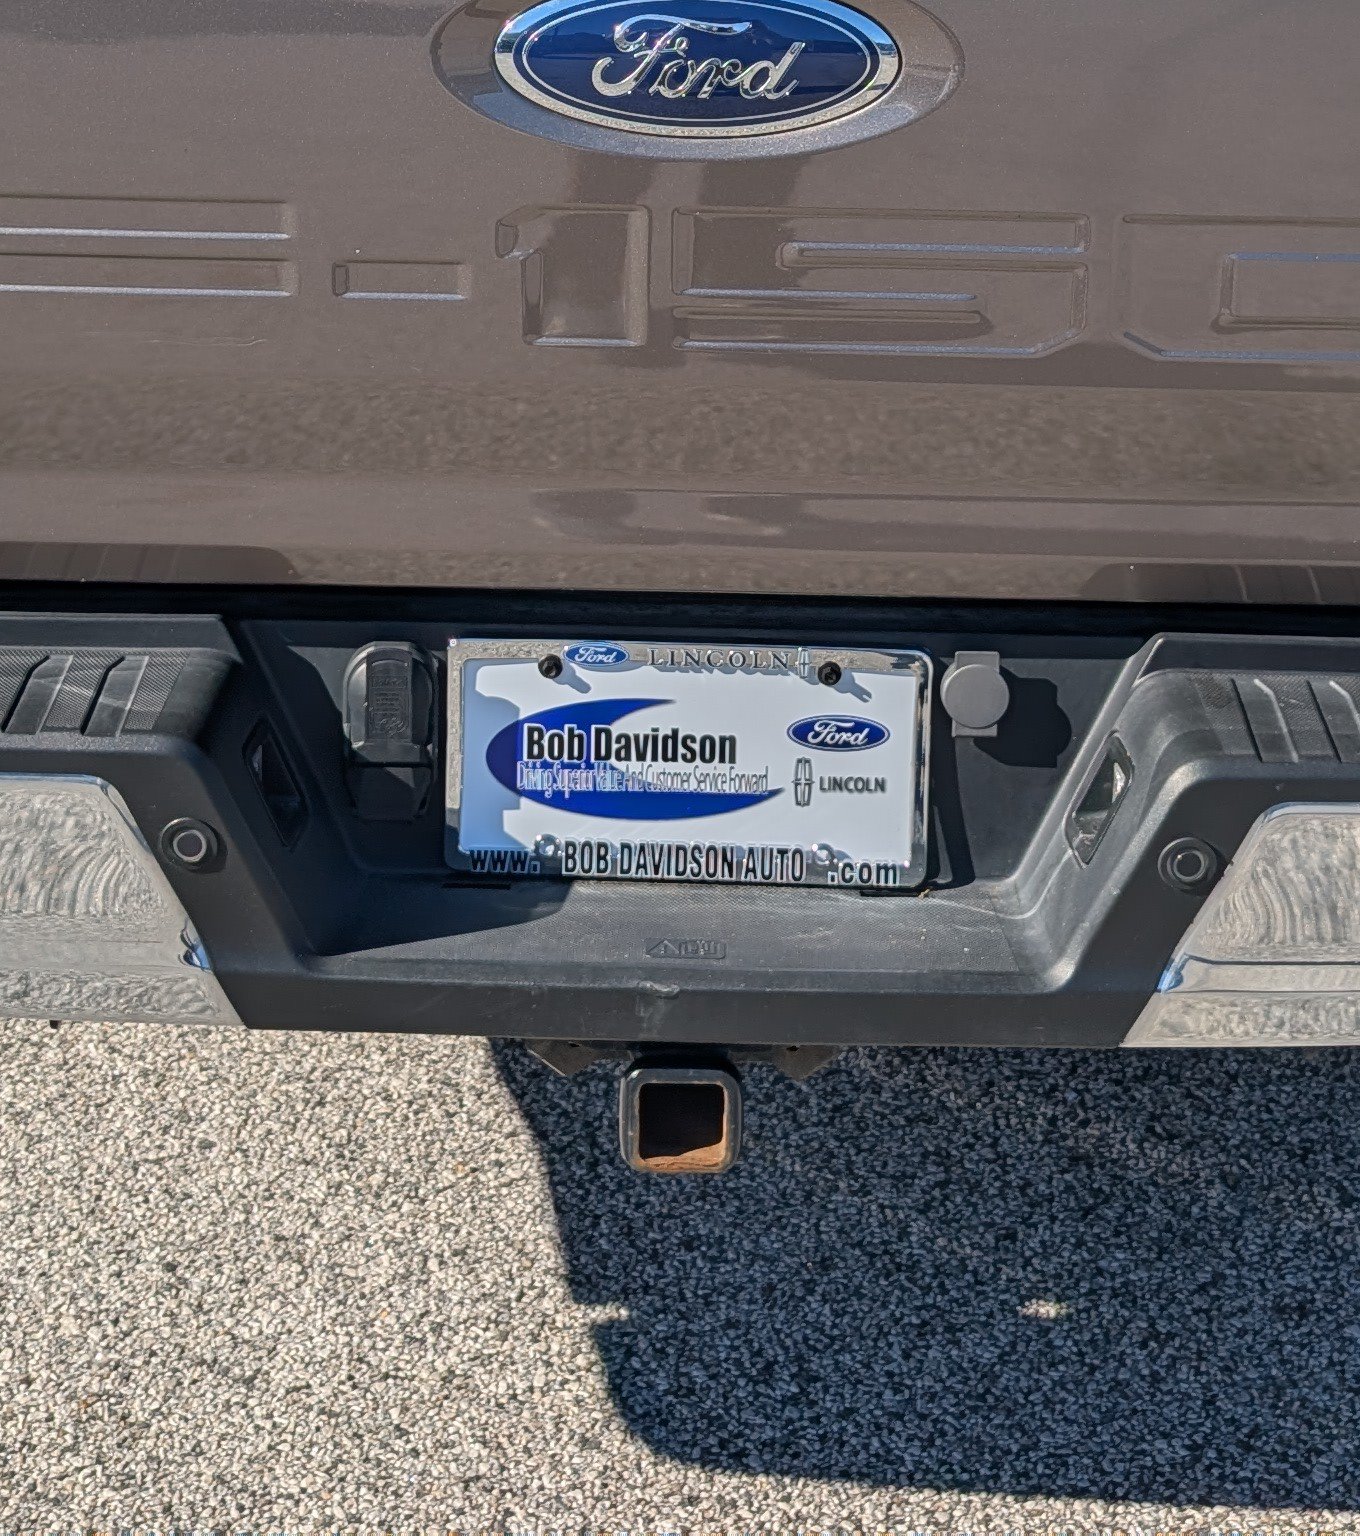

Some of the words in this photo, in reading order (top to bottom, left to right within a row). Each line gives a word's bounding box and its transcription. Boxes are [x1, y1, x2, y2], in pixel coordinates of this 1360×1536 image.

[592, 13, 807, 100] Ford
[574, 646, 616, 664] Ford
[648, 647, 791, 671] LINCOLN
[524, 723, 587, 762] Bob
[592, 725, 737, 764] Davidson
[807, 720, 870, 744] Ford
[517, 761, 553, 798] Driving
[553, 762, 594, 799] Superior
[594, 762, 624, 792] Value
[624, 764, 644, 792] And
[646, 764, 692, 793] Customer
[693, 765, 727, 794] Service
[729, 766, 769, 795] Forward
[819, 776, 887, 793] LINCOLN
[469, 850, 539, 873] www.
[562, 838, 611, 875] BOB
[617, 840, 736, 881] DAVIDSON
[741, 844, 806, 883] AUTO
[828, 859, 900, 886] .com
